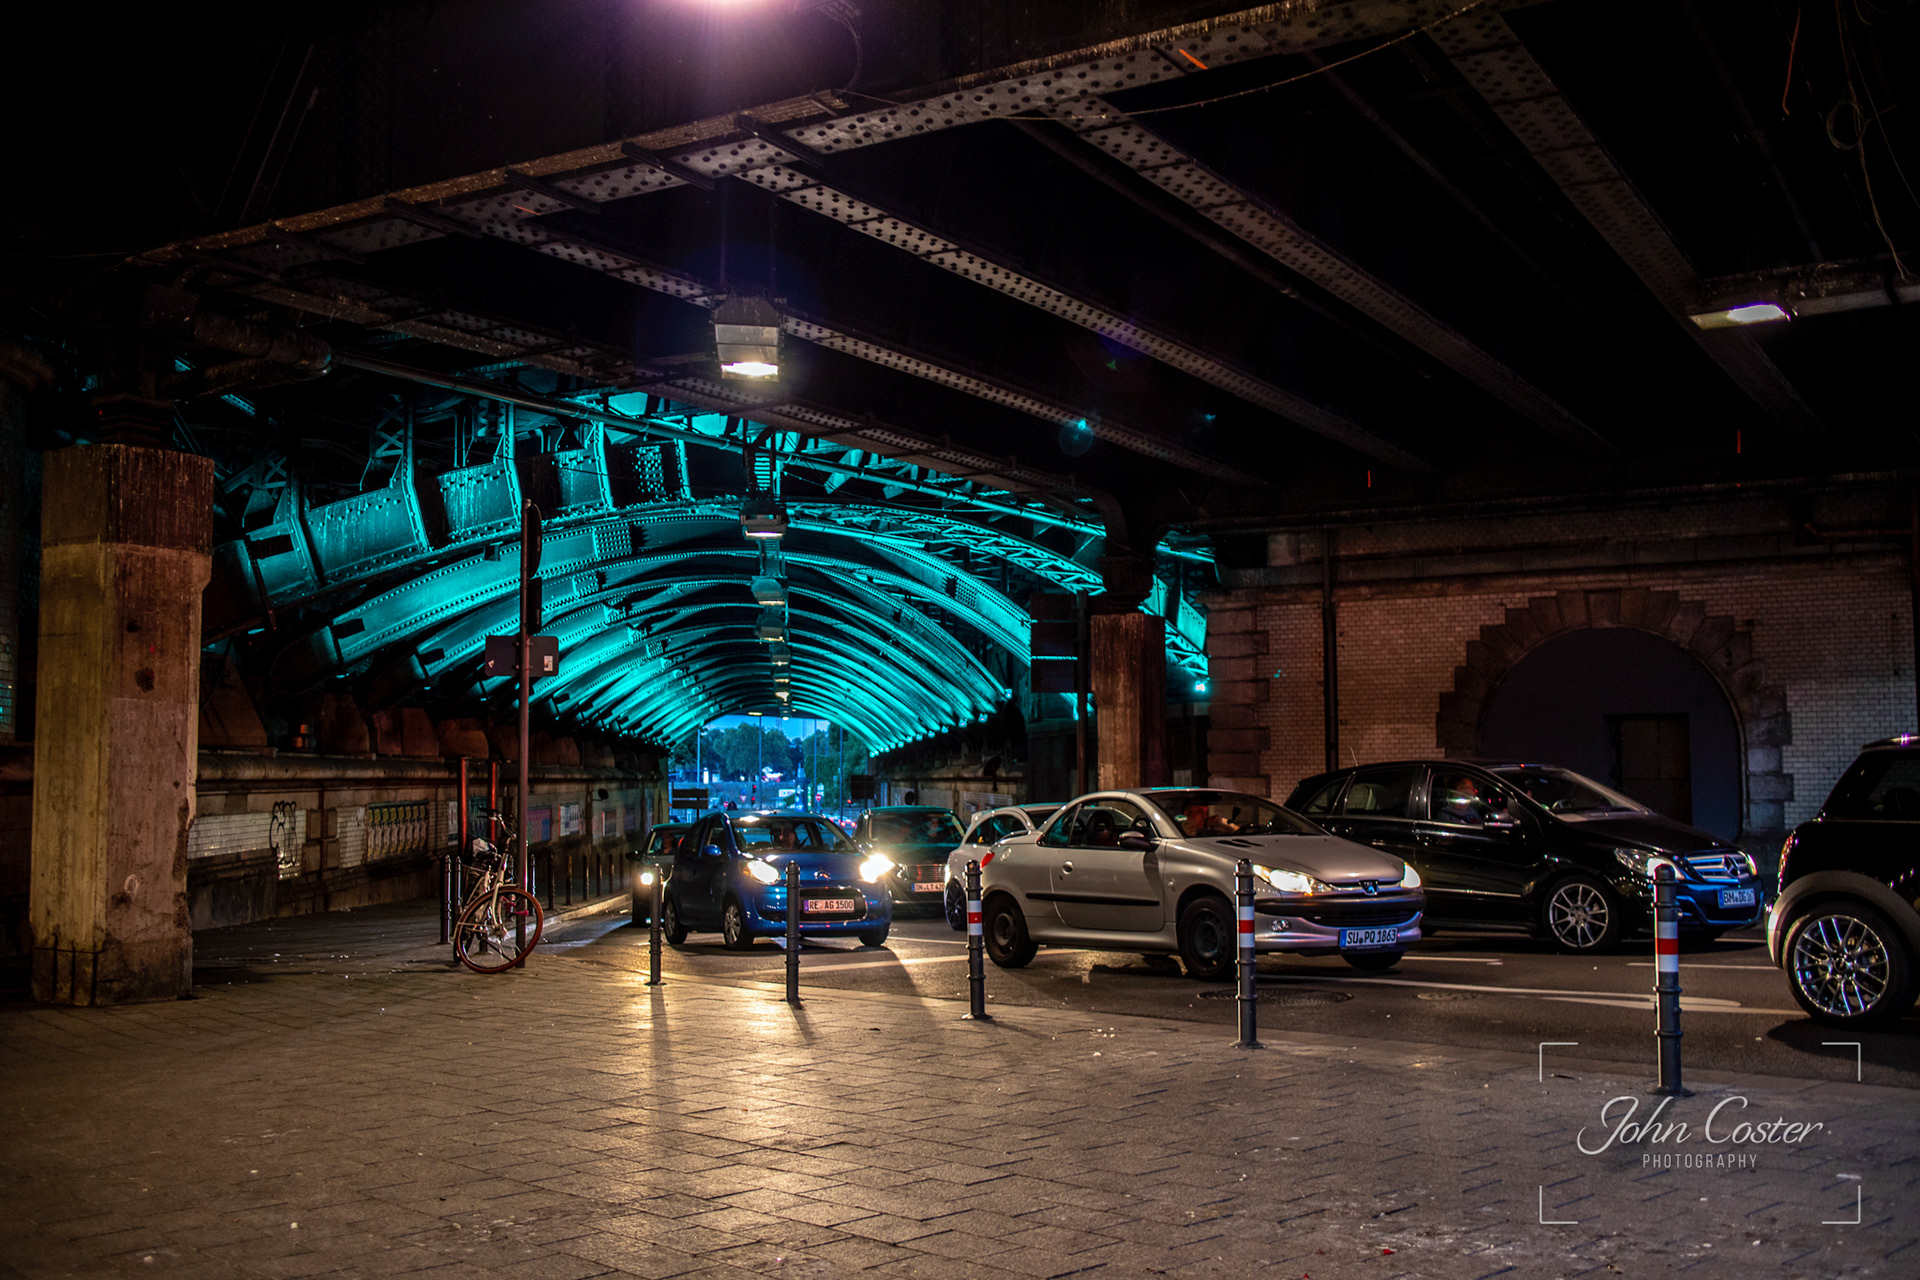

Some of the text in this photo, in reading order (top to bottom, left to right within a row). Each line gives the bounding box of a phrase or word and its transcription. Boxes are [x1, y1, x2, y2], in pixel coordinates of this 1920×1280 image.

[809, 900, 853, 910] RE AG 1500
[1346, 931, 1359, 945] SU
[1376, 928, 1397, 943] 1863
